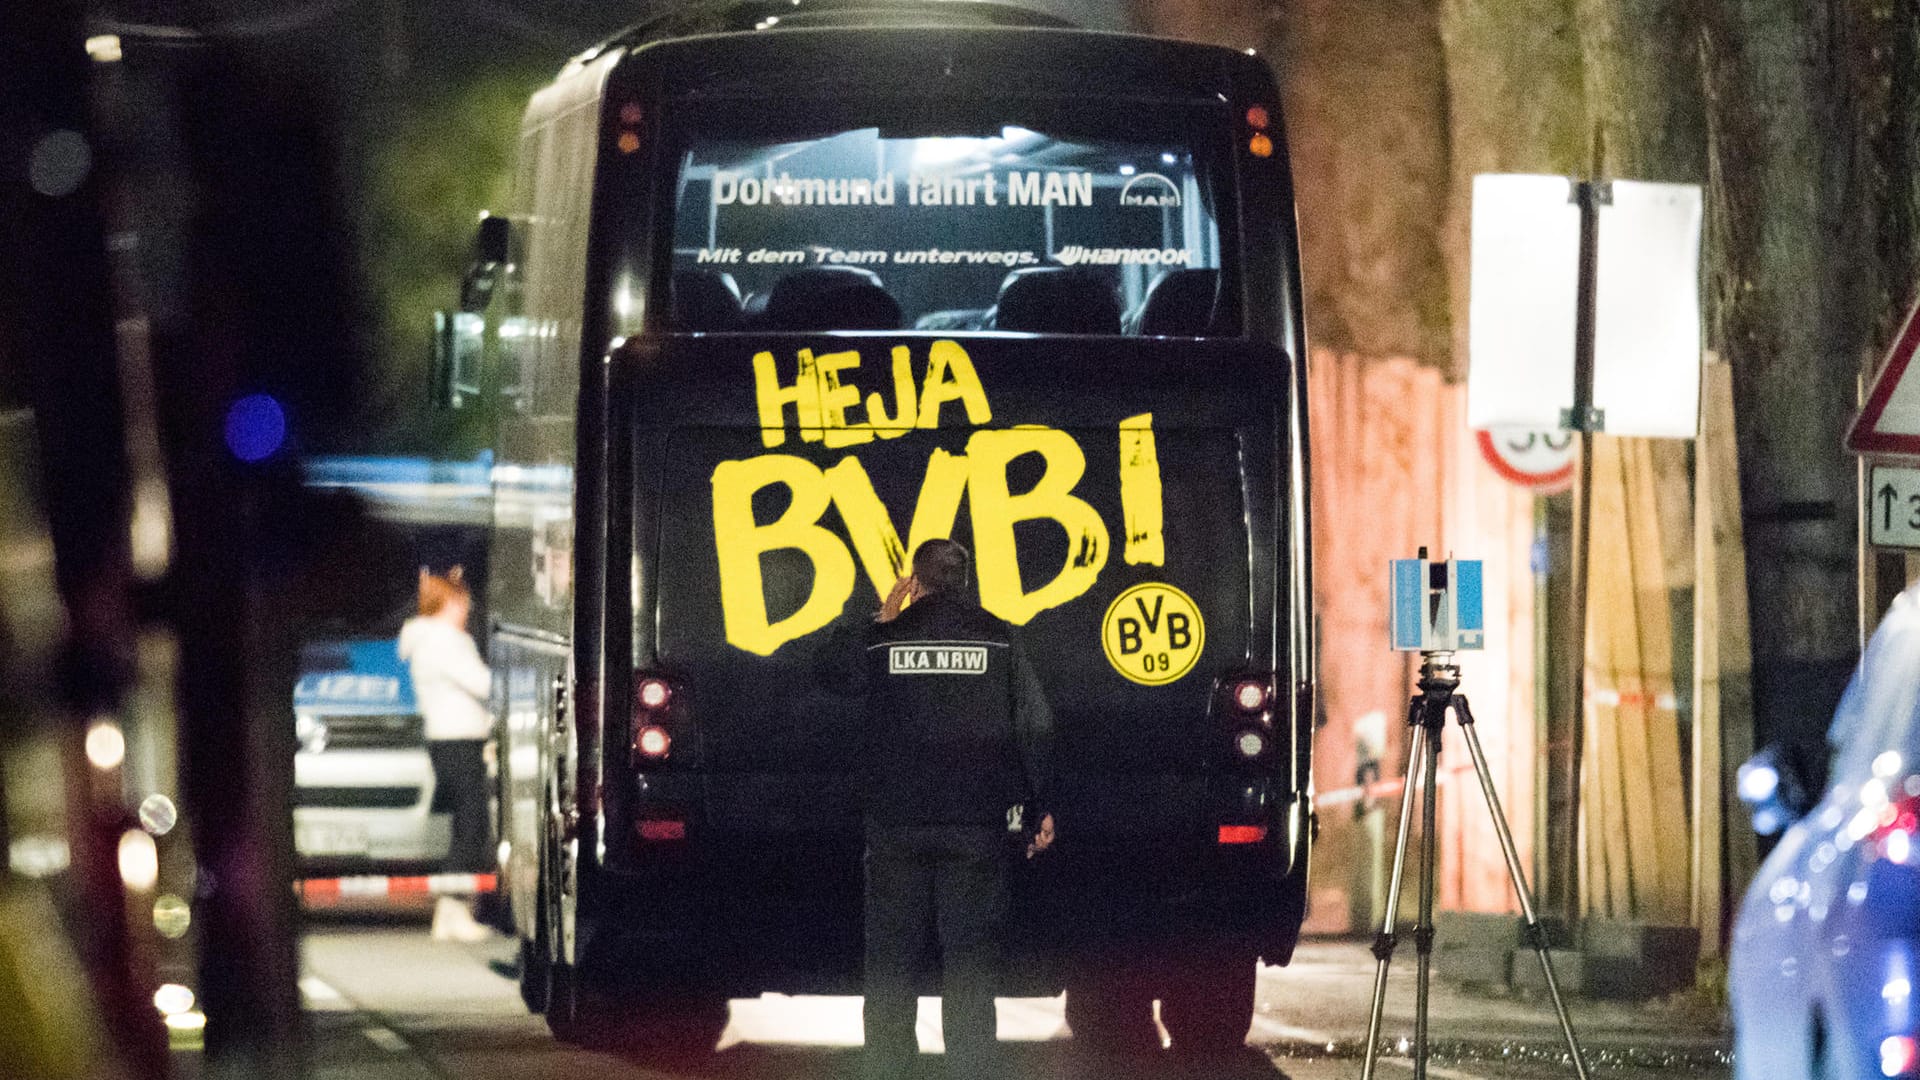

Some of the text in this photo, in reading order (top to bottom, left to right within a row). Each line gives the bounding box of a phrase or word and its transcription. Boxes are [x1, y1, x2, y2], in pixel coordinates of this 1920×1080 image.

[714, 171, 895, 205] Dortmund
[1008, 171, 1092, 206] MAN
[1125, 195, 1175, 206] MAN
[697, 247, 1039, 266] Mit dem Team unterwegs.
[752, 340, 992, 449] HEJA
[711, 412, 1165, 657] BVB!
[1117, 594, 1192, 656] BVB
[894, 651, 982, 669] LKA NRW
[1143, 652, 1170, 673] 09
